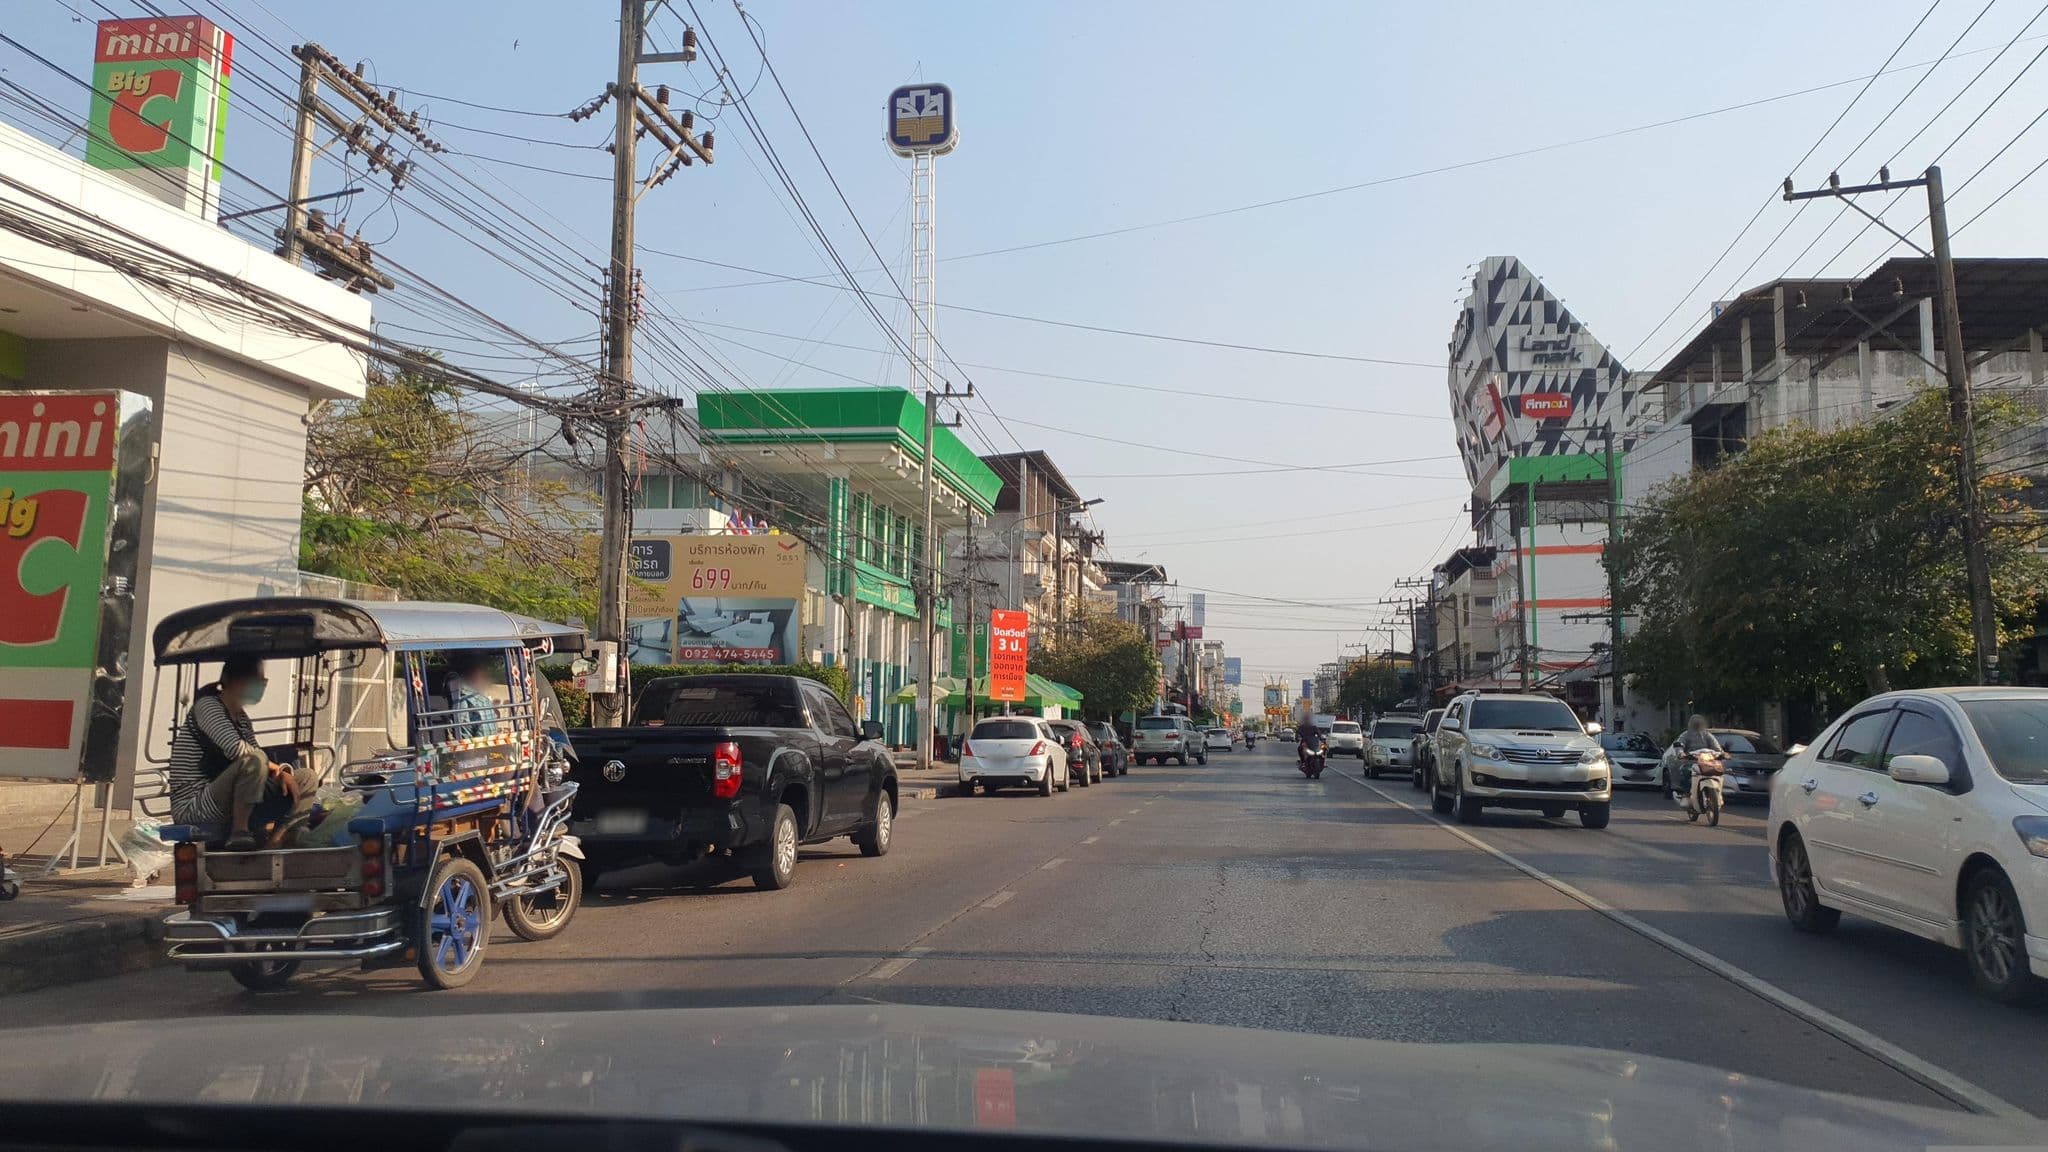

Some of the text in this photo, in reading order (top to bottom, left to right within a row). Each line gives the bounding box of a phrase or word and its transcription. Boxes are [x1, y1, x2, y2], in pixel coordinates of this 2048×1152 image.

[106, 21, 195, 56] mini
[108, 70, 152, 96] Big
[1520, 335, 1572, 352] Land
[1533, 348, 1583, 364] mark
[0, 488, 38, 537] ig
[689, 543, 765, 556] บริการห้องพัก
[692, 568, 731, 590] 699
[998, 638, 1007, 651] 3
[685, 649, 774, 659] 092 474-5445
